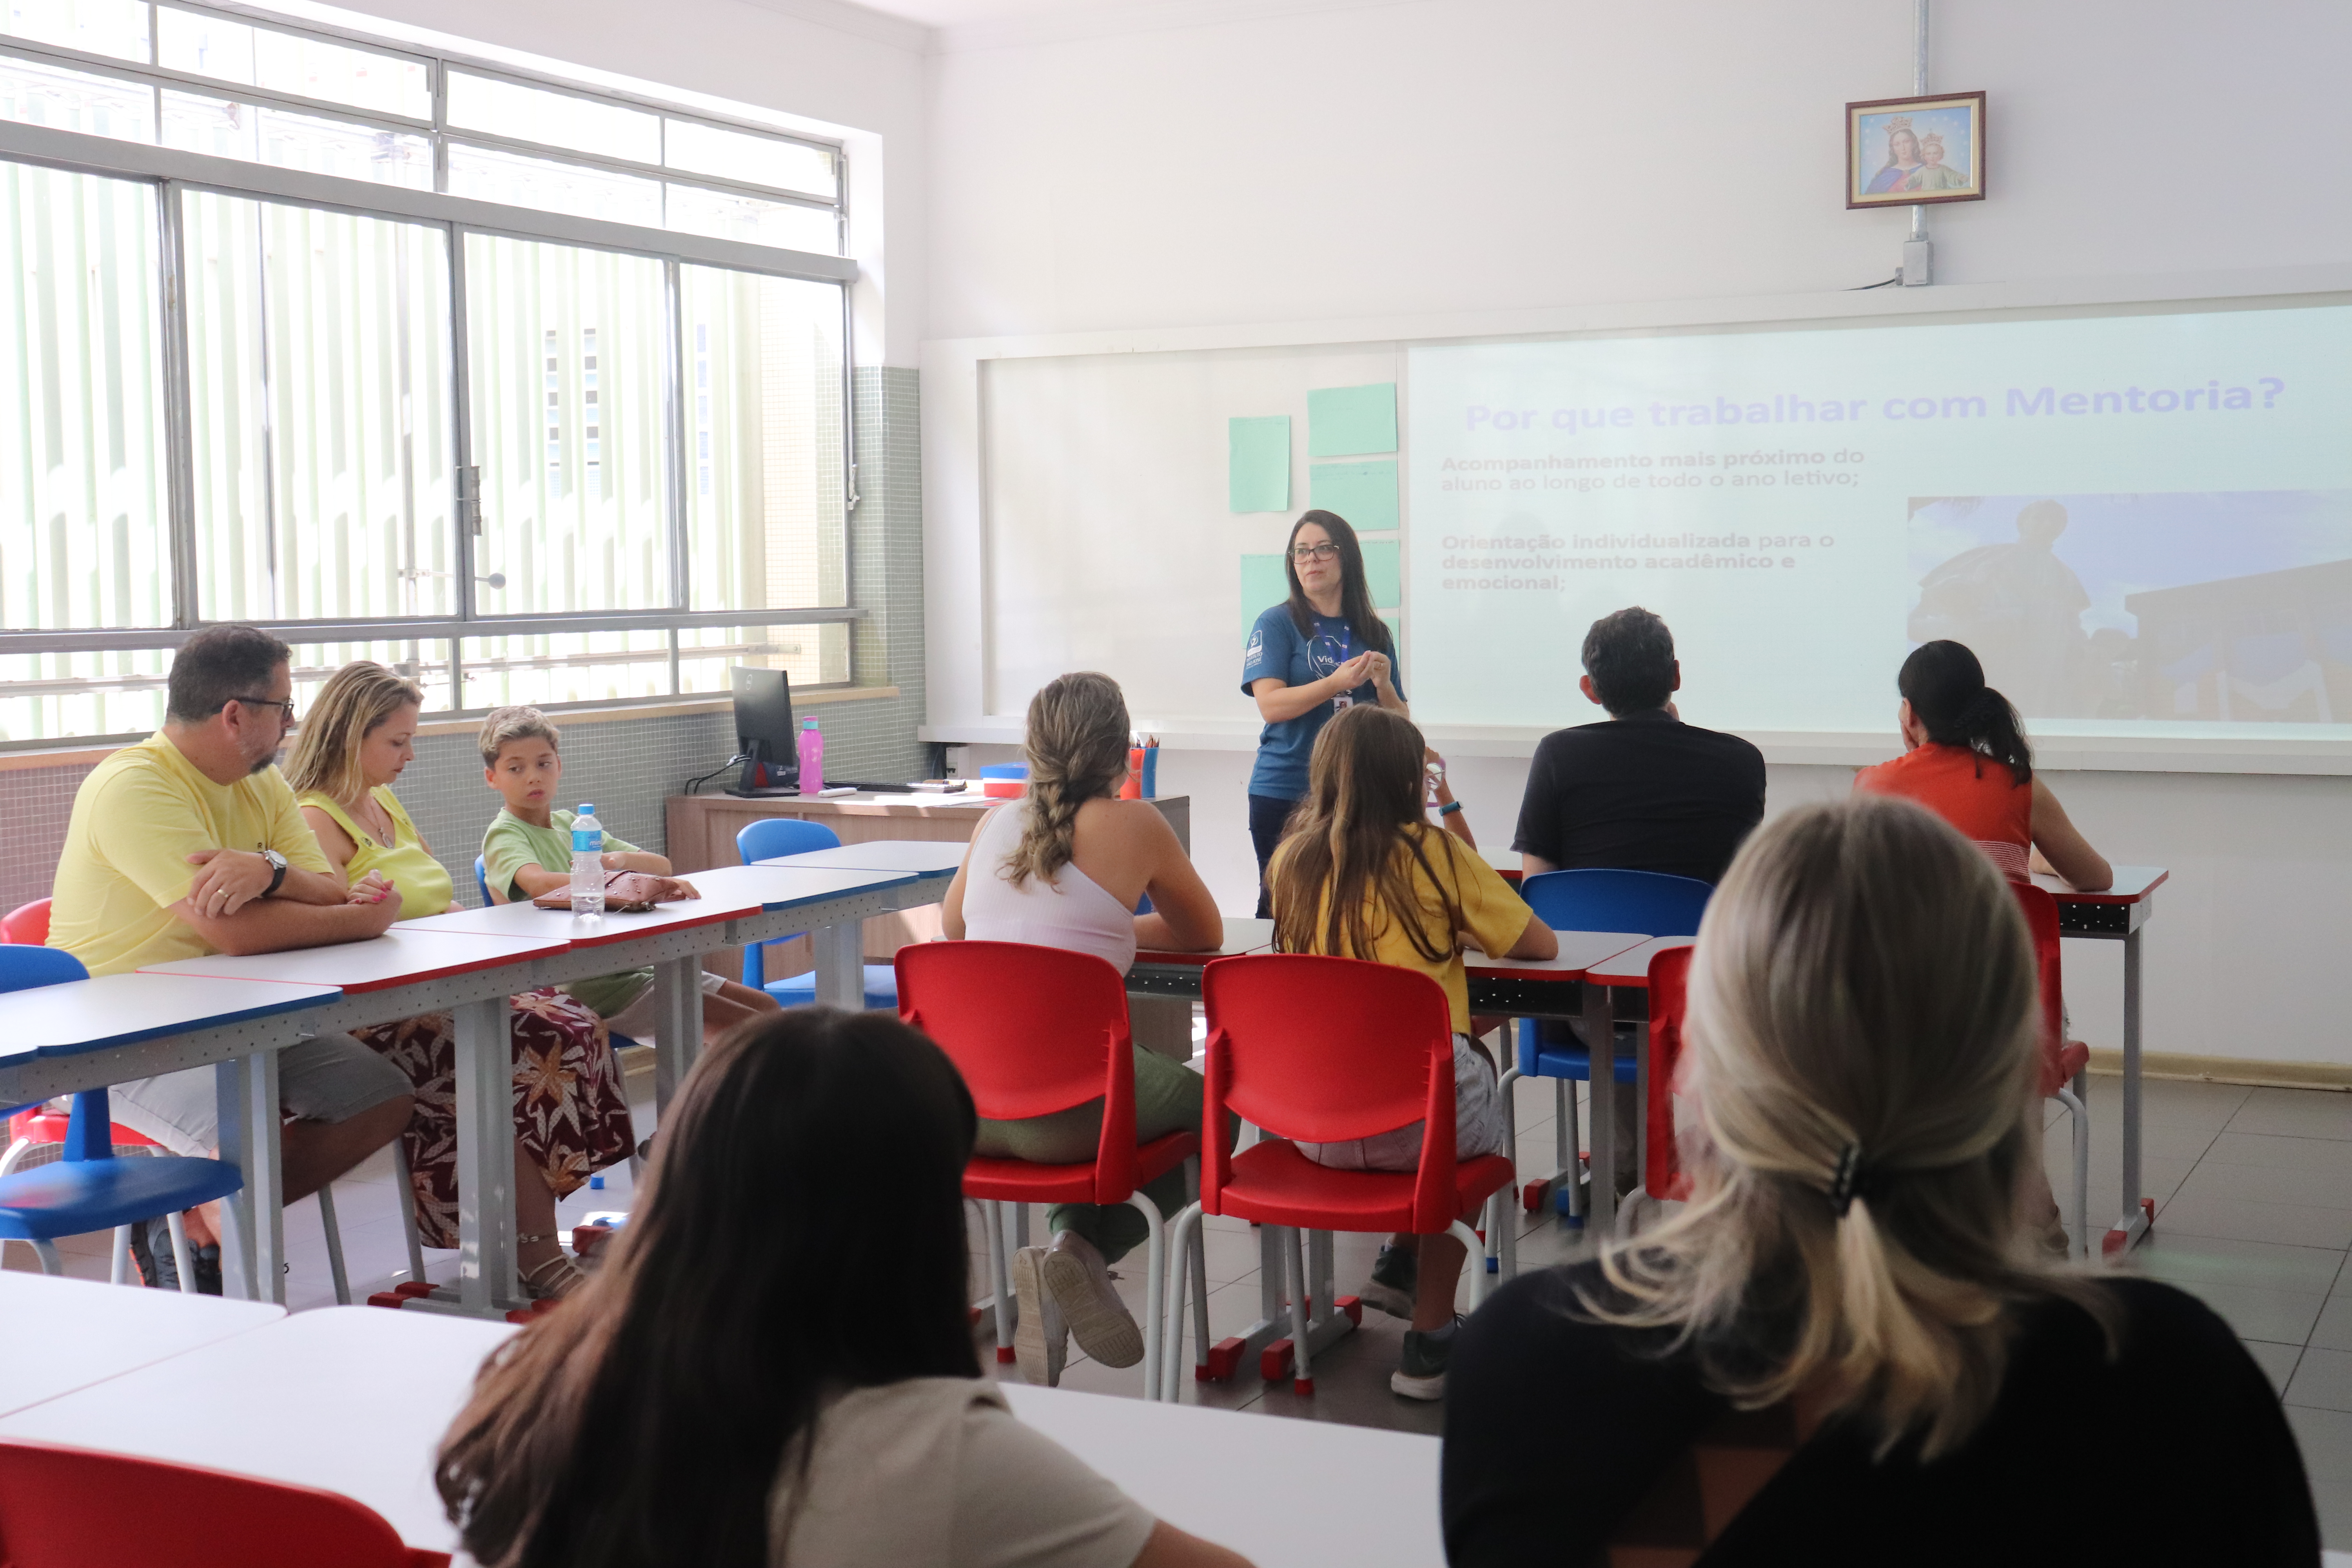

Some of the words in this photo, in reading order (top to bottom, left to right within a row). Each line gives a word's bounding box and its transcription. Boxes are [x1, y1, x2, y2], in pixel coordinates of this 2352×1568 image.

[1466, 405, 1538, 431] Por
[1552, 406, 1634, 436] que
[1648, 394, 1867, 427] trabalhar
[1882, 395, 1987, 420] com
[2005, 377, 2285, 417] Mentoria?
[1441, 454, 1652, 474] Acompanhamento
[1660, 451, 1716, 468] mais
[1723, 449, 1826, 469] próximo
[1833, 448, 1865, 465] do
[1441, 475, 1503, 491] aluno
[1509, 476, 1536, 490] ao
[1543, 474, 1606, 493] longo
[1613, 474, 1641, 488] de
[1648, 472, 1702, 487] todo
[1709, 474, 1724, 487] o
[1731, 471, 1776, 487] ano
[1784, 470, 1860, 488] letivo;
[1441, 534, 1566, 554] Orientação
[1572, 533, 1750, 550] individualizada
[1758, 534, 1812, 552] para
[1819, 534, 1835, 548] o
[1441, 554, 1638, 571] desenvolvimento
[1644, 554, 1774, 569] acadêmico
[1780, 554, 1795, 569] e
[1441, 575, 1566, 592] emocional;
